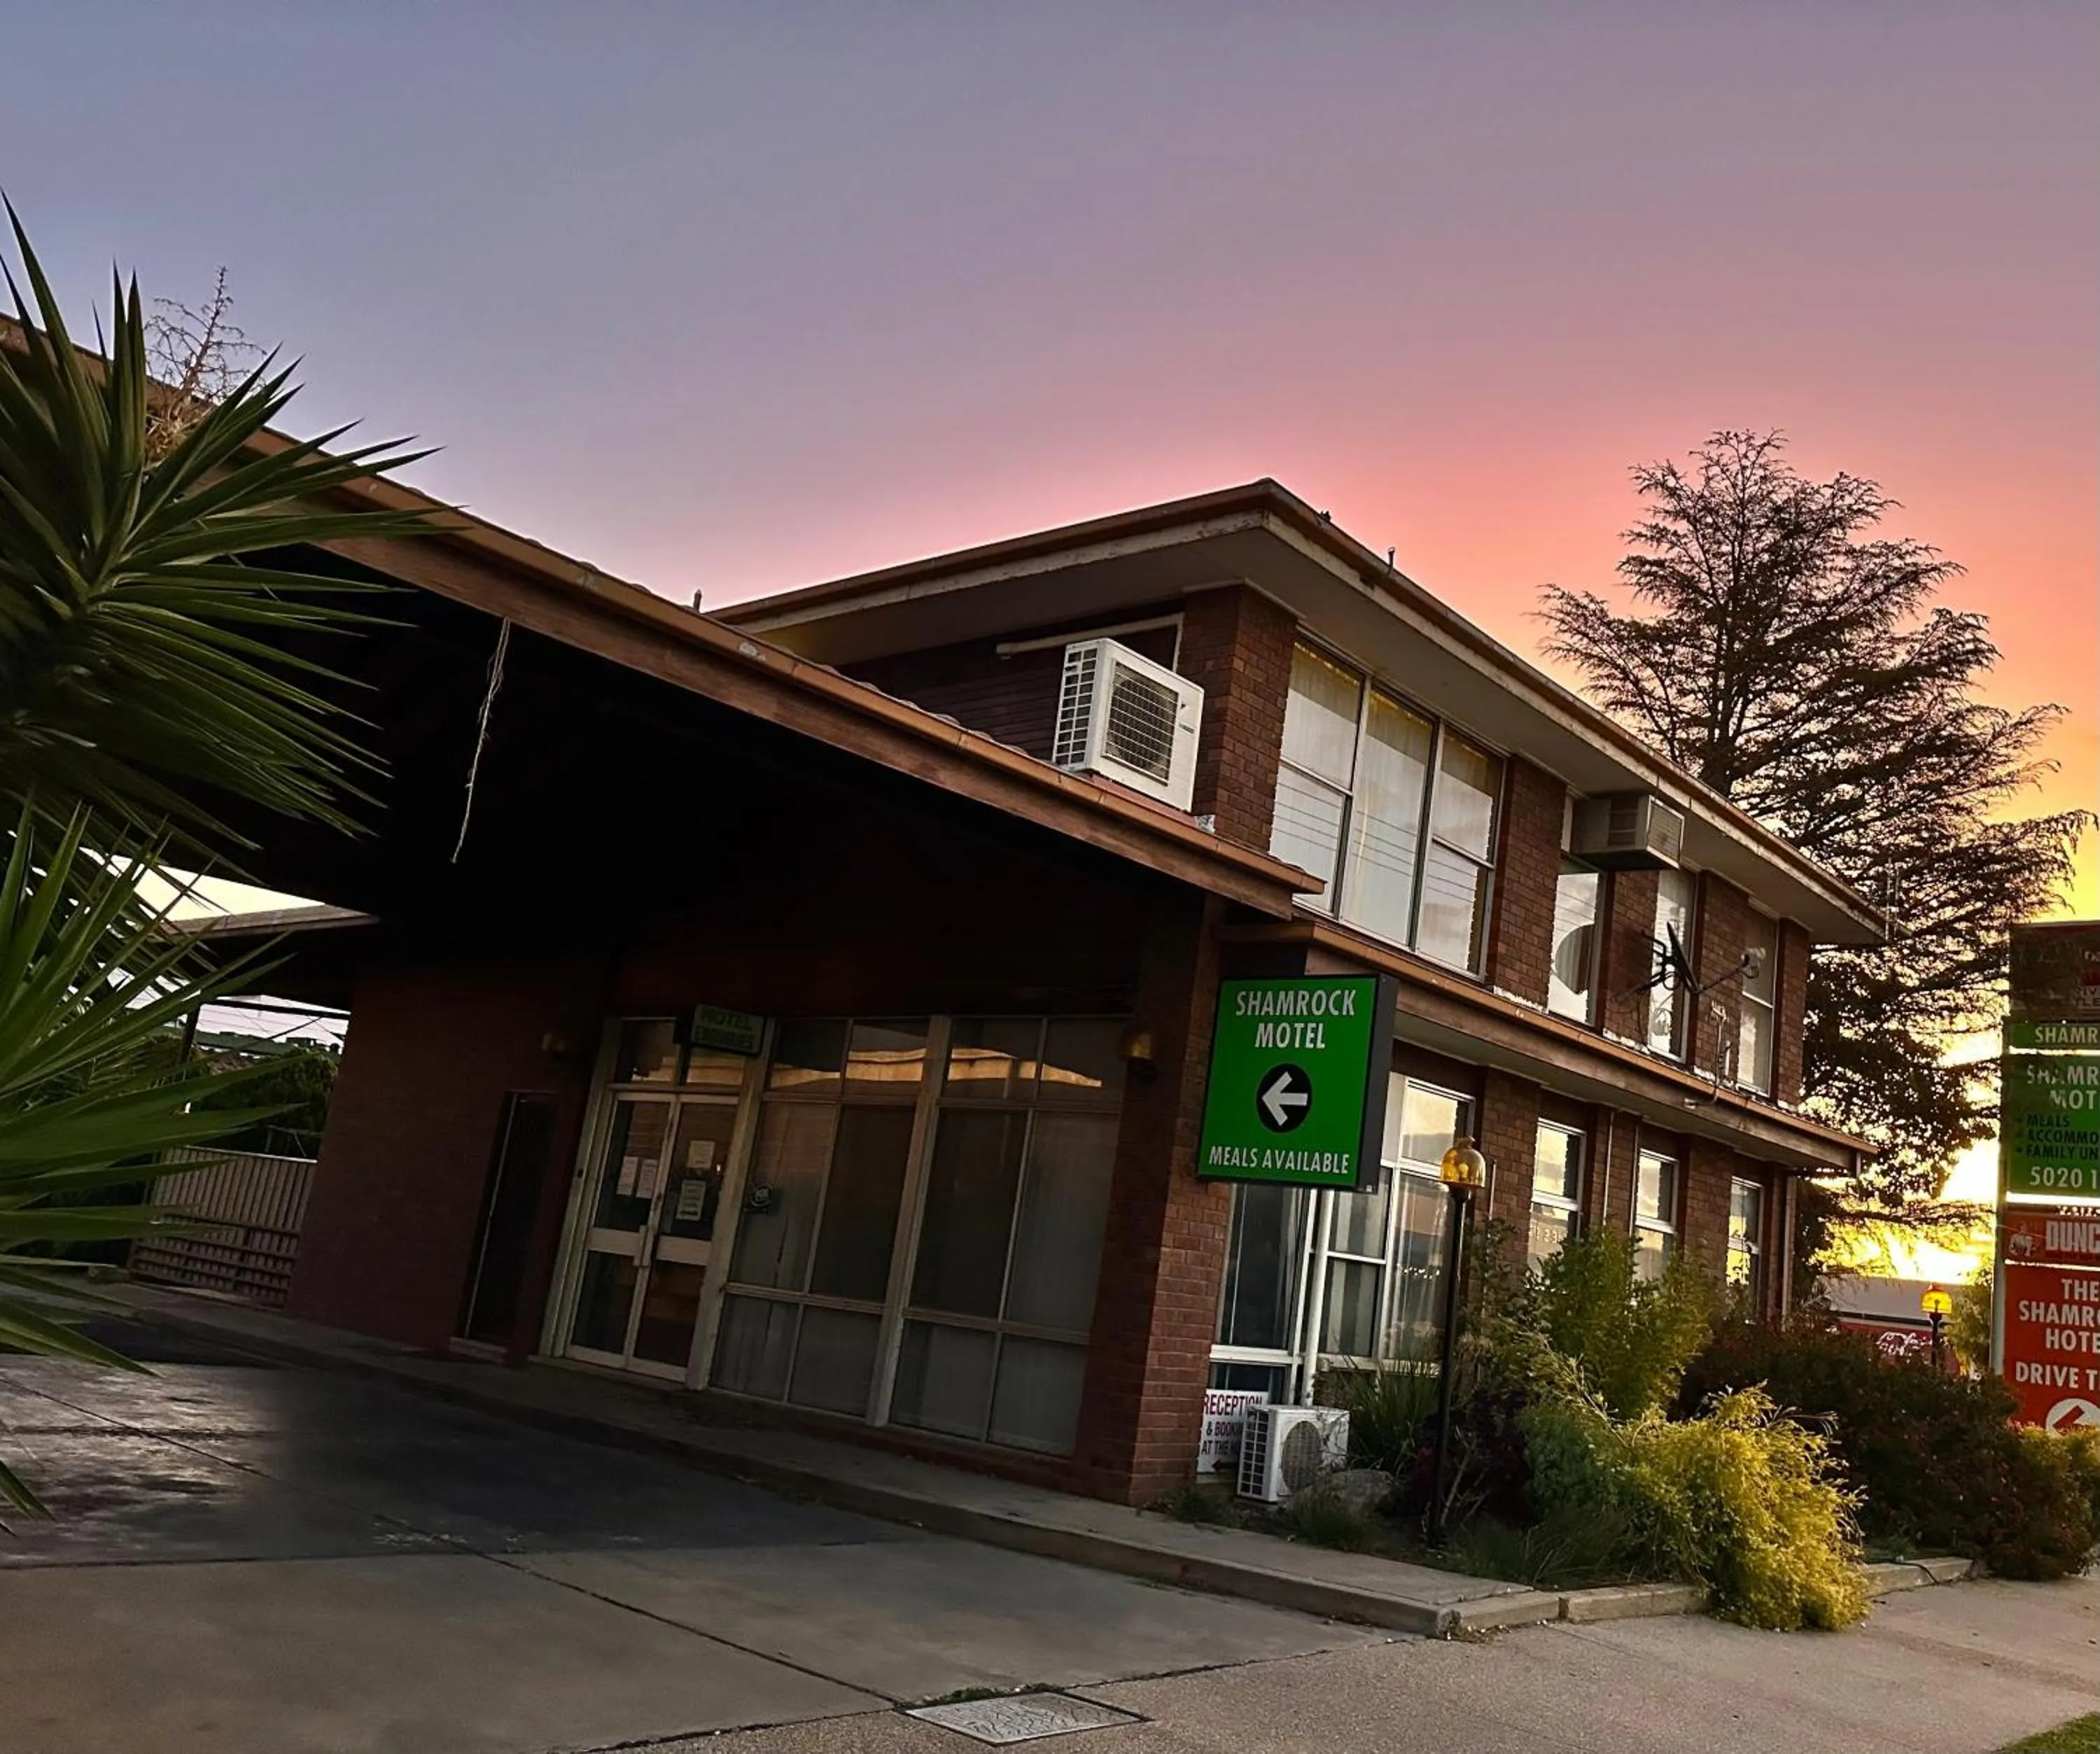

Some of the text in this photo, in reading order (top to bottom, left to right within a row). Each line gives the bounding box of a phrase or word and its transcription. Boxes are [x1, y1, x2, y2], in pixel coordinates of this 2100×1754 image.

[1236, 990, 1356, 1017] SHAMROCK
[1254, 1023, 1326, 1049] MOTEL
[2035, 1026, 2098, 1044] SHAMR
[2026, 1114, 2070, 1127] MEALS
[1209, 1146, 1350, 1174] MEALS AVAILABLE
[2026, 1144, 2075, 1159] FAMILY
[2029, 1166, 2082, 1188] 5020
[2061, 1279, 2100, 1302] THE
[2019, 1300, 2100, 1326] SHAMR
[2015, 1361, 2079, 1389] DRIVE
[1206, 1422, 1213, 1436] &
[1201, 1440, 1212, 1455] AT
[1214, 1440, 1230, 1455] THE
